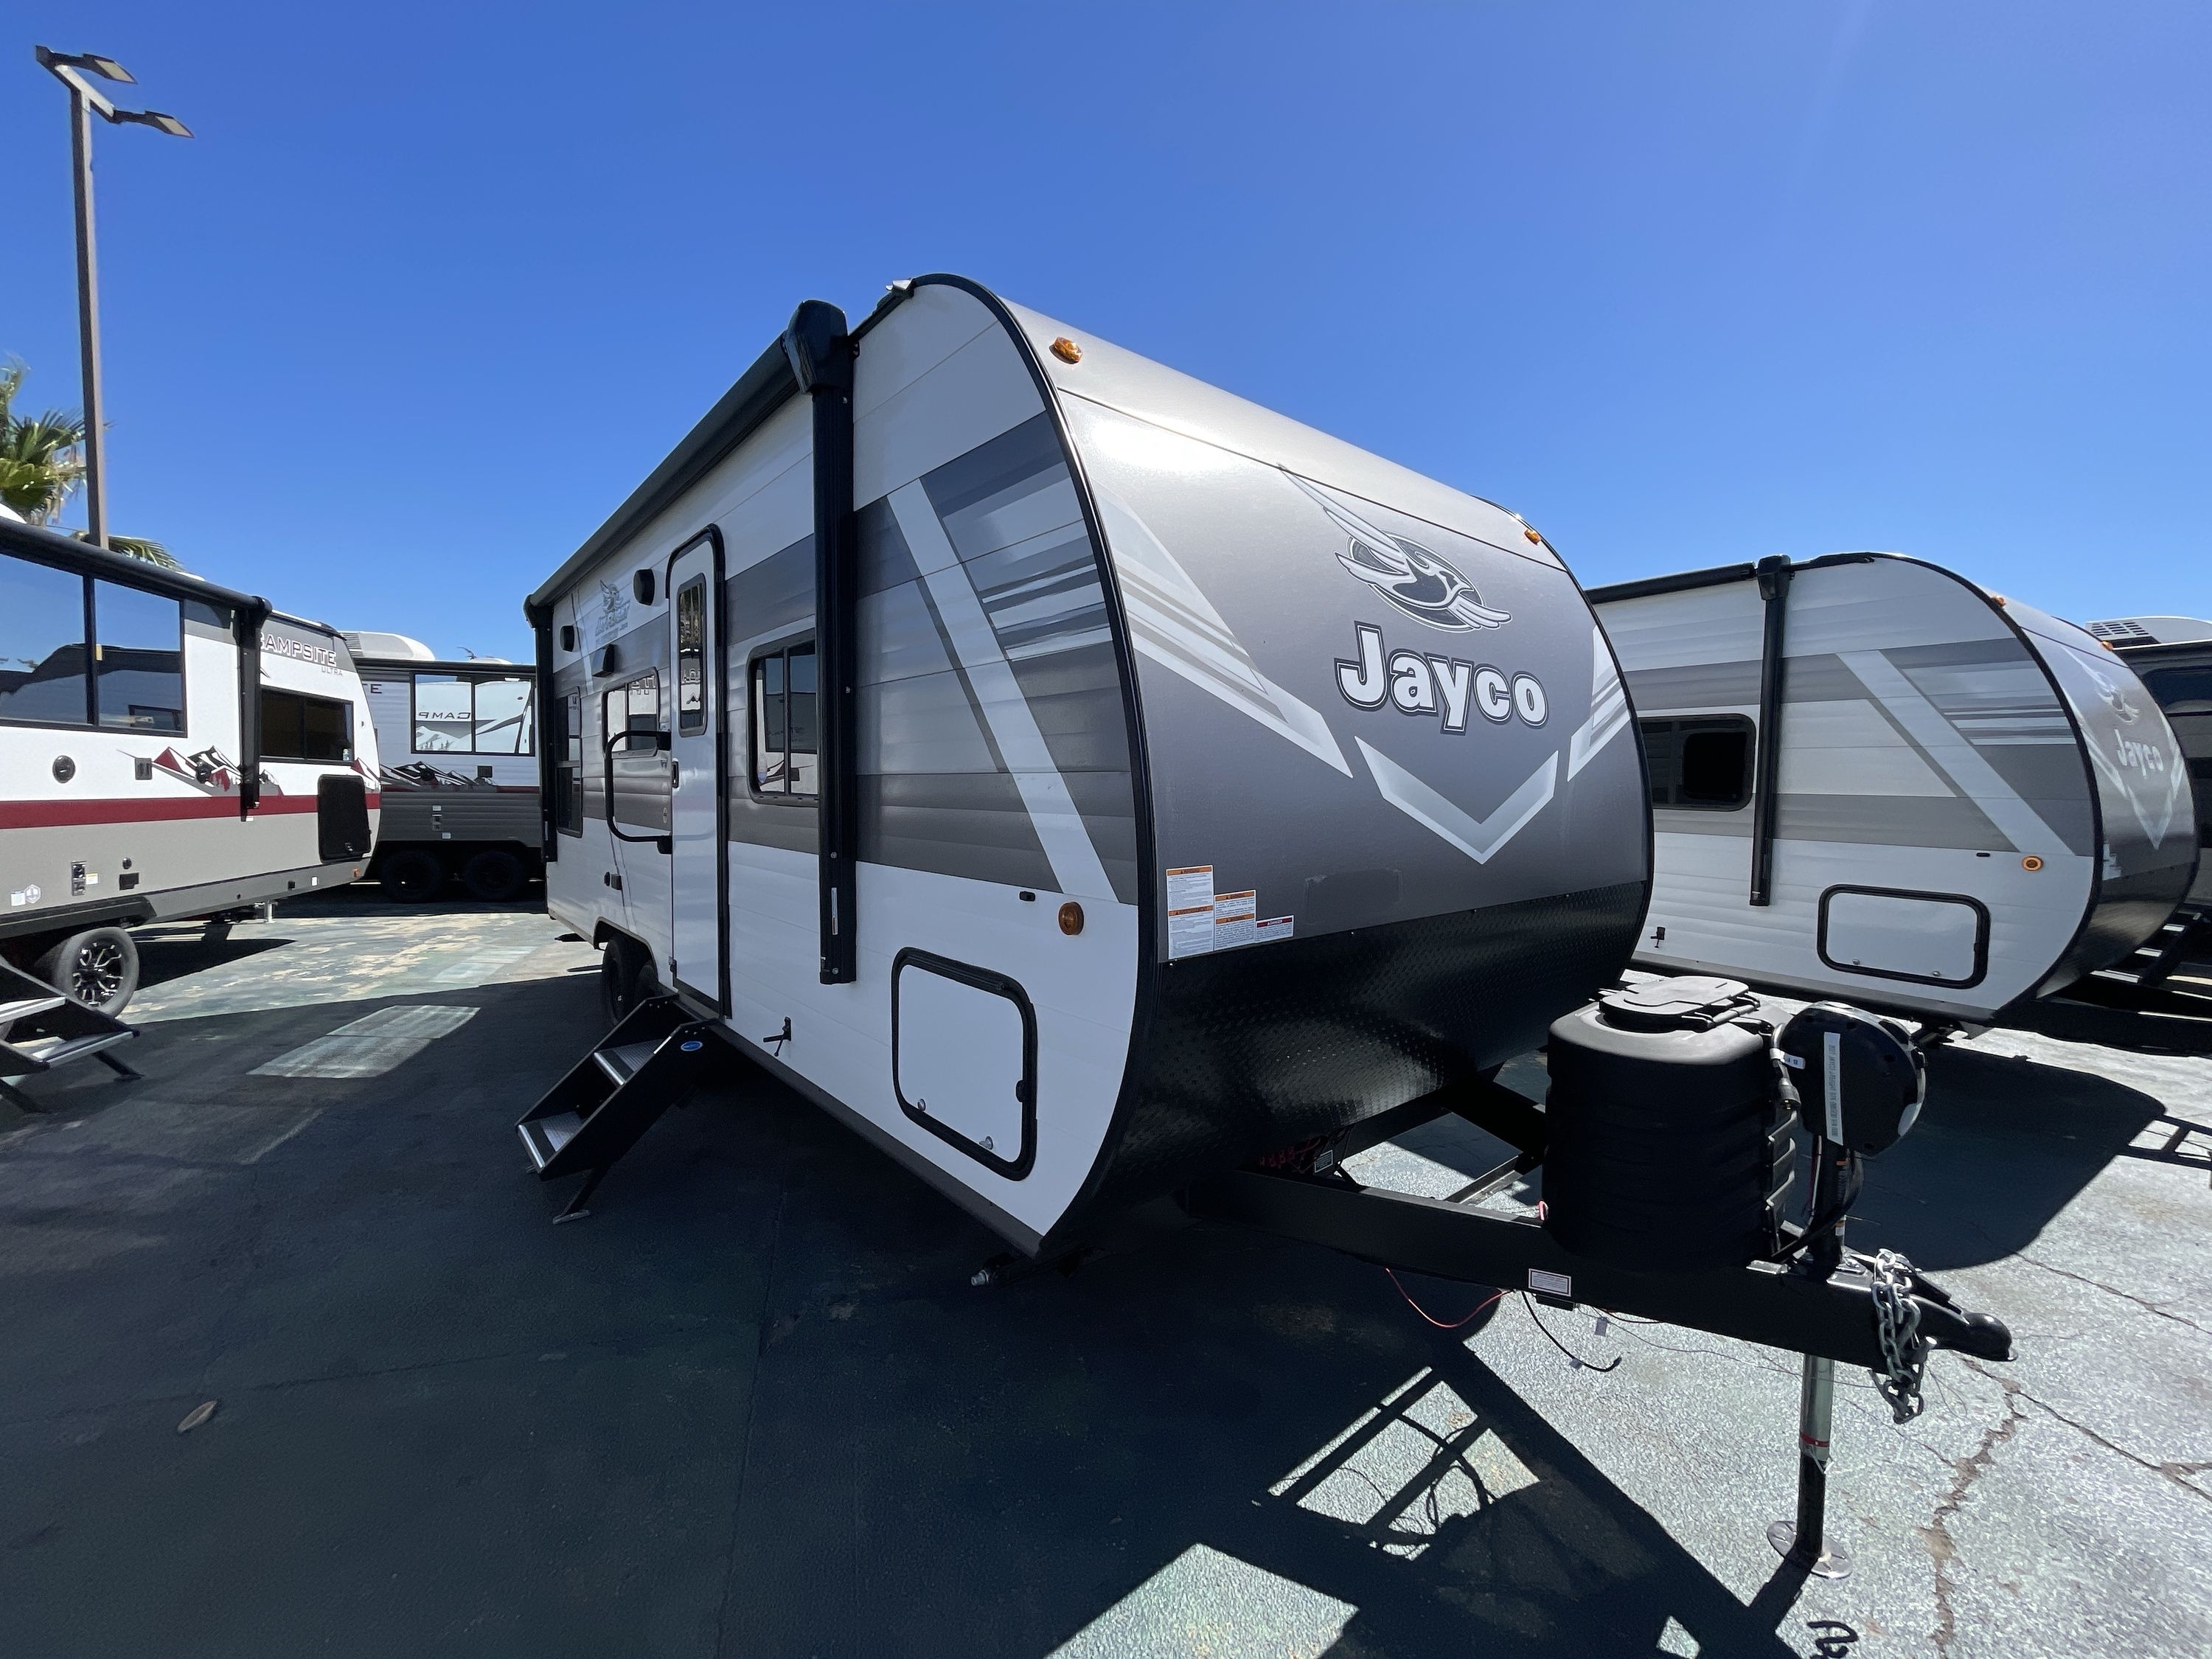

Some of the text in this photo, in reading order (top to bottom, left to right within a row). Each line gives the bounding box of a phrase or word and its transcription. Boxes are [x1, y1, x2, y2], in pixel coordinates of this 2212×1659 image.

[321, 666, 343, 676] ULTRA
[1334, 620, 1548, 736] Jayco
[2113, 728, 2163, 779] Jayco
